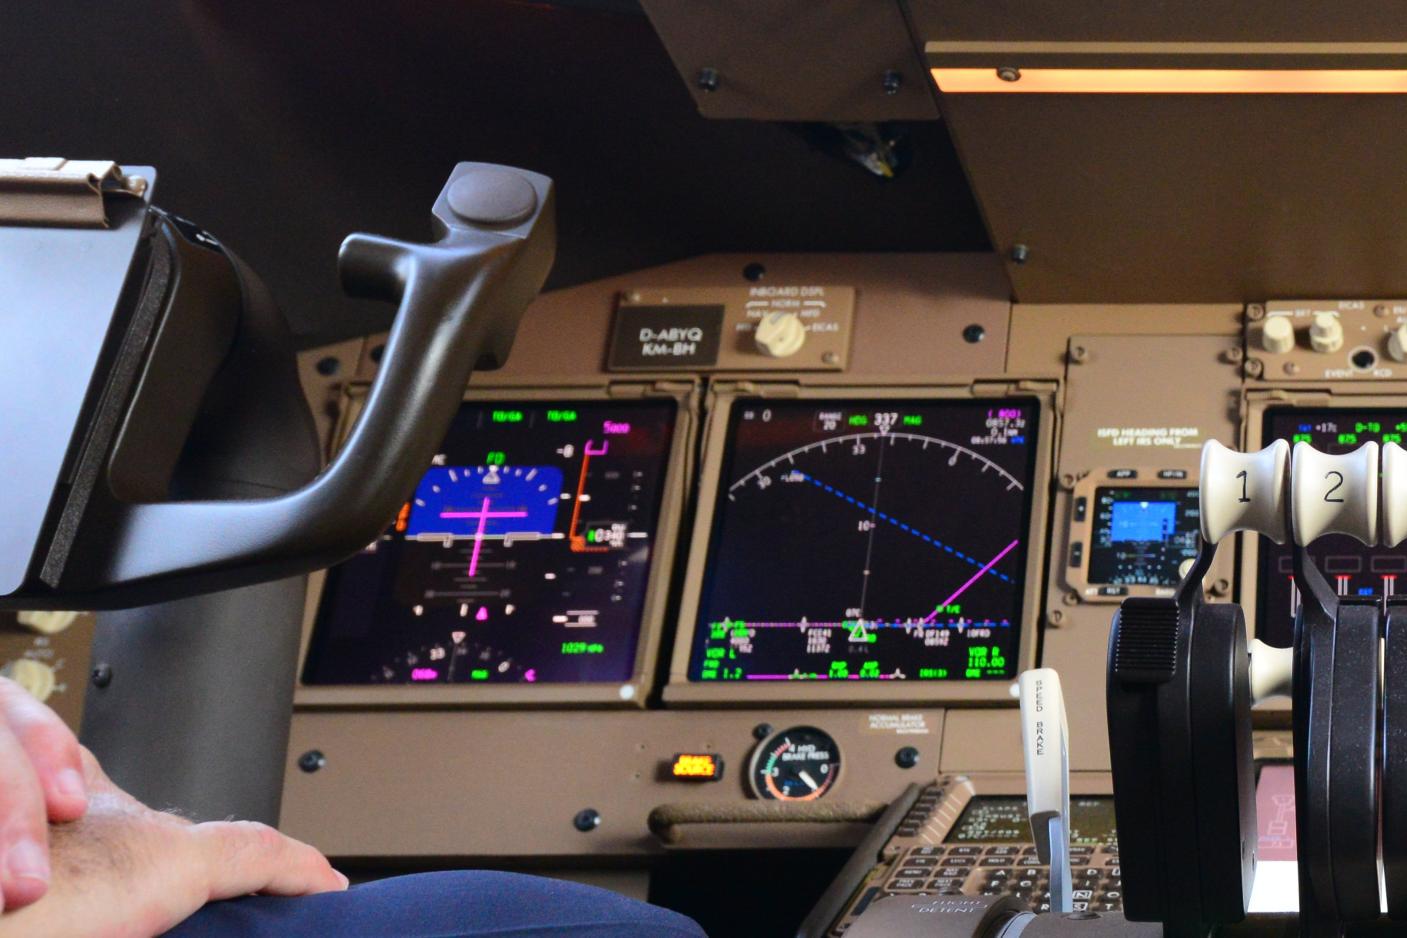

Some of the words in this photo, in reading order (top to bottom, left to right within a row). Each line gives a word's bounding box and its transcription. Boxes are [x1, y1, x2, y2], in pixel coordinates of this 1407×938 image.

[639, 327, 703, 342] D-ABYQ
[641, 342, 697, 356] KM-BH
[762, 409, 772, 422] 0
[874, 412, 898, 426] 337
[1121, 428, 1167, 437] HEADING
[1169, 427, 1199, 437] FROM
[1236, 470, 1251, 503] 1
[1323, 470, 1344, 503] 2
[1036, 721, 1044, 756] BRAKE
